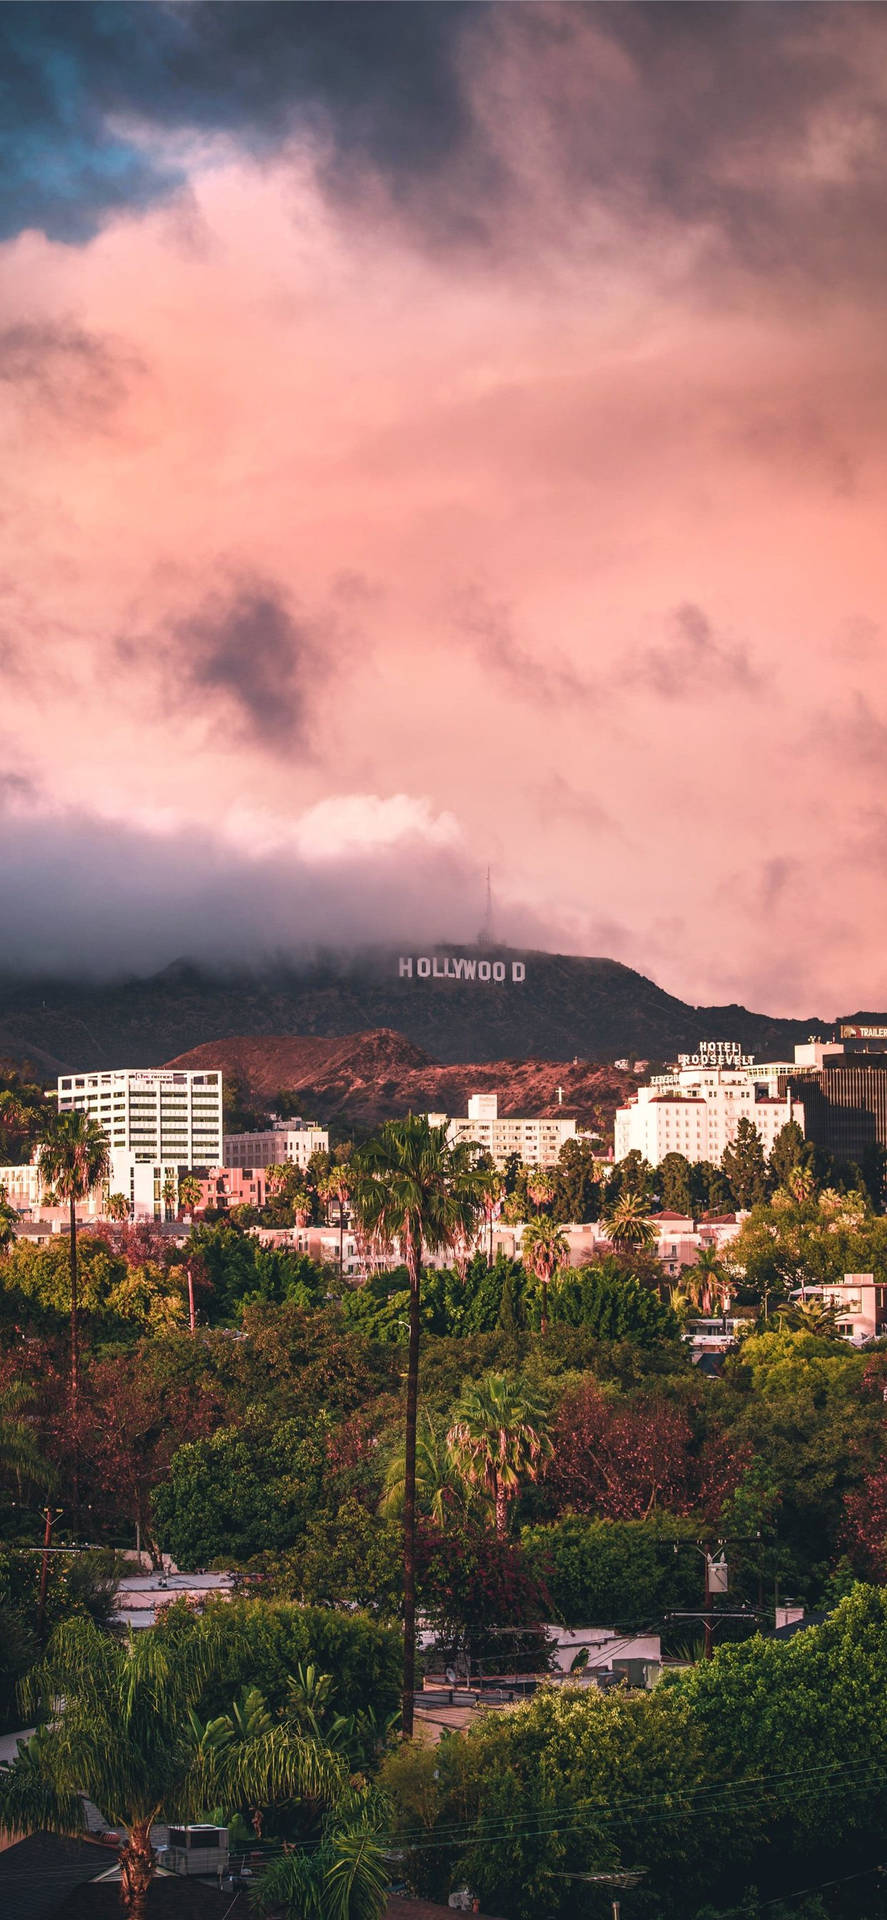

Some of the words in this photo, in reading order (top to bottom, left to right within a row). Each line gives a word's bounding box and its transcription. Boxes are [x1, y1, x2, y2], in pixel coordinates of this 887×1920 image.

[399, 957, 526, 982] HOLLYWOOD
[700, 1041, 738, 1052] HOTEL
[683, 1054, 755, 1065] ROOSEVELT
